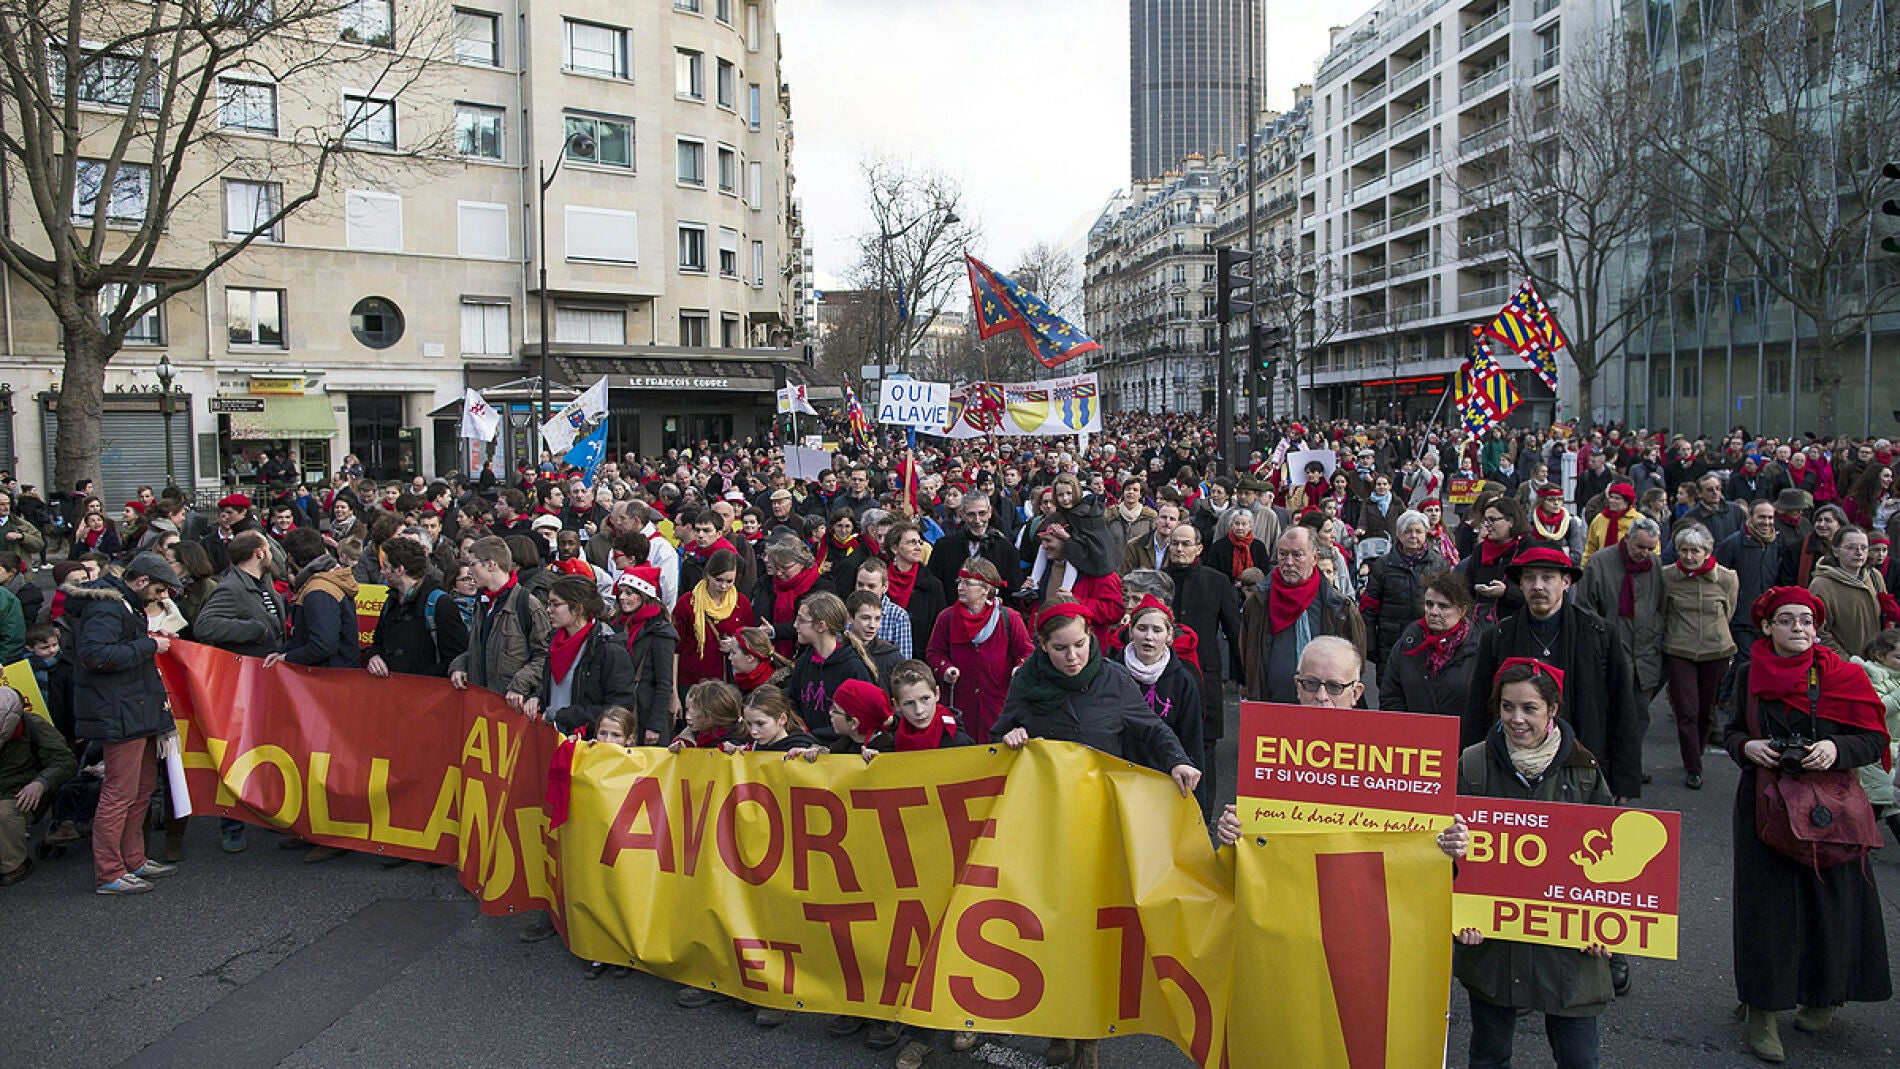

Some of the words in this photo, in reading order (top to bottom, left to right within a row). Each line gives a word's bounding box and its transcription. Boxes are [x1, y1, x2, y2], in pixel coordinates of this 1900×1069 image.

[115, 384, 184, 394] KAYSR
[891, 384, 932, 402] OUI
[1452, 484, 1467, 492] BIO
[1255, 735, 1442, 779] ENCEINTE
[1254, 767, 1274, 780] ET
[1277, 769, 1292, 782] SI
[1295, 770, 1337, 786] VOUS
[1340, 773, 1361, 788] LE
[1363, 777, 1442, 795] GARDIEZ?
[1254, 805, 1286, 822] pour
[1291, 805, 1304, 820] le
[1307, 808, 1345, 826] droit
[1348, 812, 1379, 829] d'en
[1467, 809, 1488, 824] JE
[1492, 811, 1550, 829] PENSE
[599, 775, 1007, 893] AVORTE
[1465, 829, 1549, 868] BIO
[1543, 884, 1565, 900] JE
[1569, 886, 1632, 907] GARDE
[1636, 893, 1660, 909] LE
[1492, 900, 1660, 950] PETIOT
[732, 937, 802, 995] ET
[803, 898, 1045, 1020] TAS
